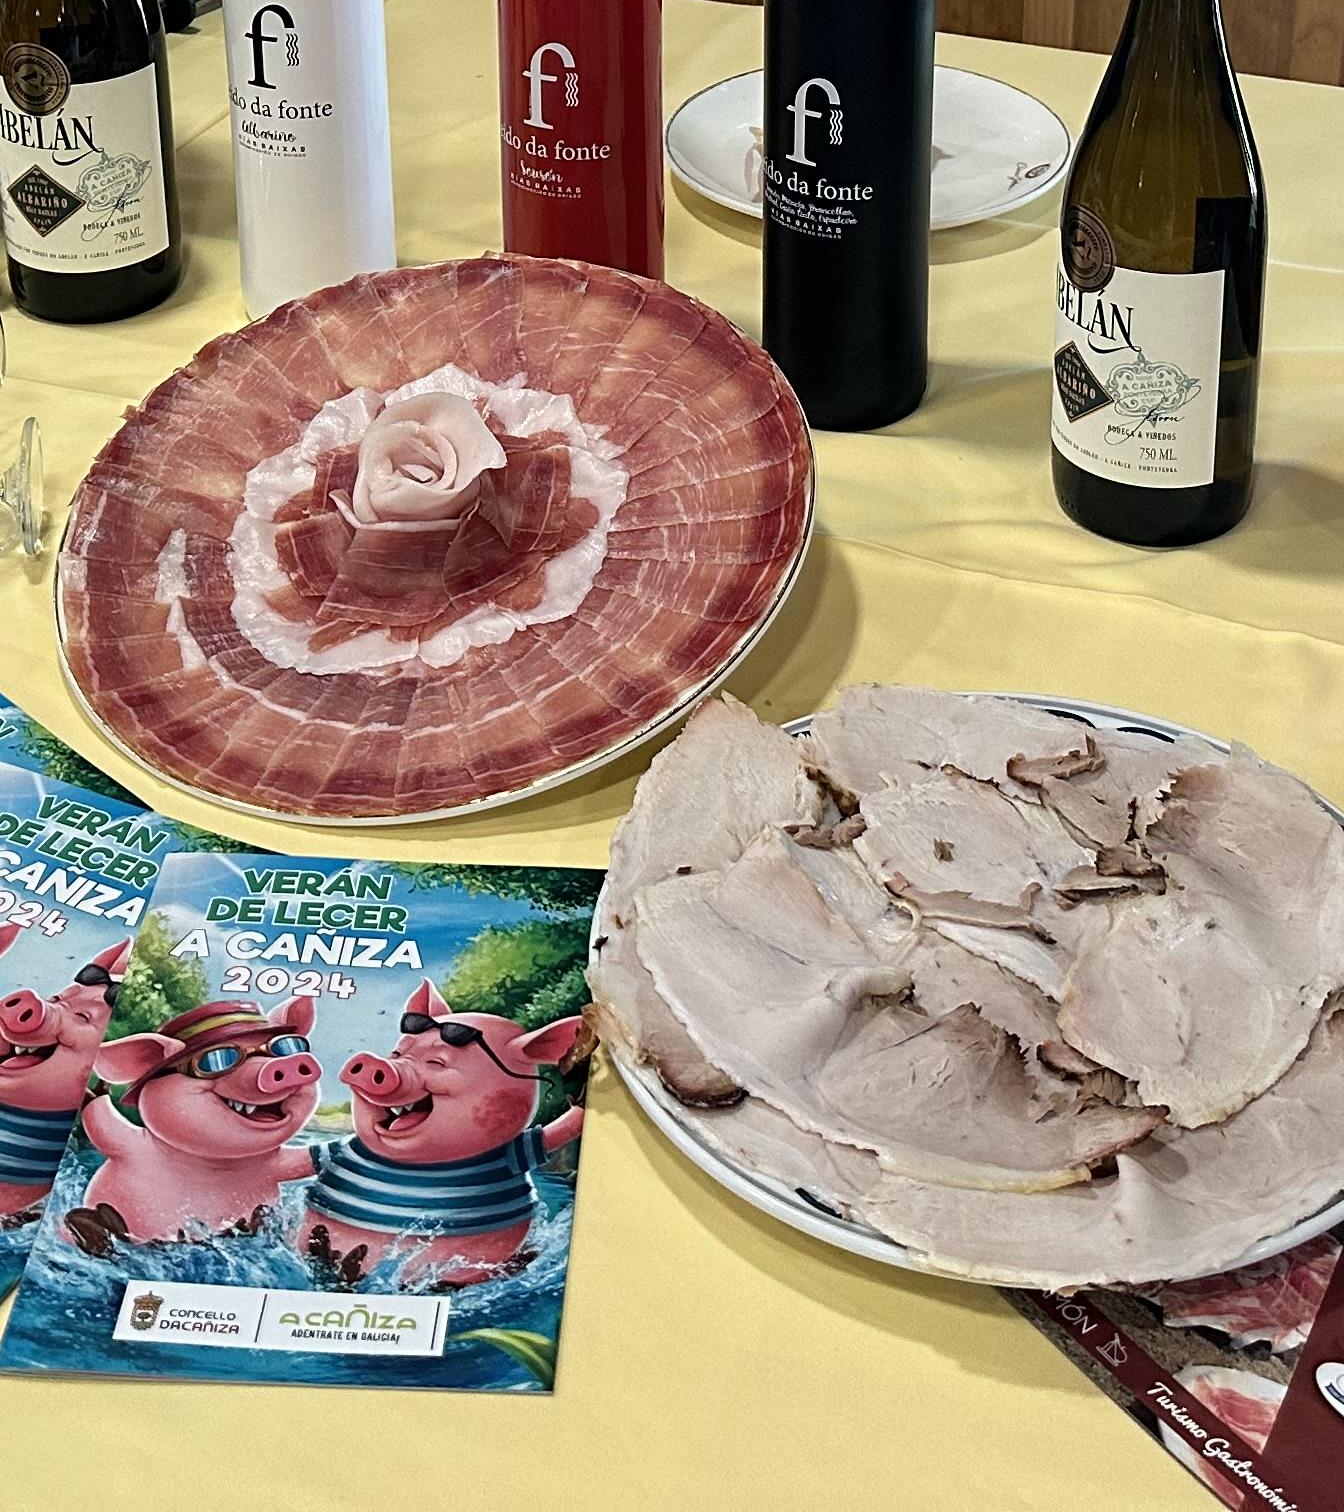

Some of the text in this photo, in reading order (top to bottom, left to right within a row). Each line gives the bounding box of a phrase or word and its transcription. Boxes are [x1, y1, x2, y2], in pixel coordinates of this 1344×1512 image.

[244, 4, 295, 90] f
[522, 42, 576, 130] f
[251, 96, 333, 119] da fonte
[786, 78, 841, 167] f
[526, 136, 611, 161] da fonte
[787, 172, 874, 201] da fonte
[114, 226, 144, 244] 750 ML
[1139, 446, 1177, 461] 750 ML
[1145, 432, 1177, 441] VIÑEDOS
[36, 794, 172, 854] VERÁN
[39, 833, 161, 890] LECER
[242, 866, 394, 901] VERÁN
[205, 897, 409, 935] DE LECER
[168, 928, 424, 970] A CAÑIZA
[220, 966, 357, 1000] 2024
[168, 1307, 237, 1322] CONCELLO
[304, 1303, 418, 1331] CAÑIZA
[1145, 1380, 1208, 1441] Turismo
